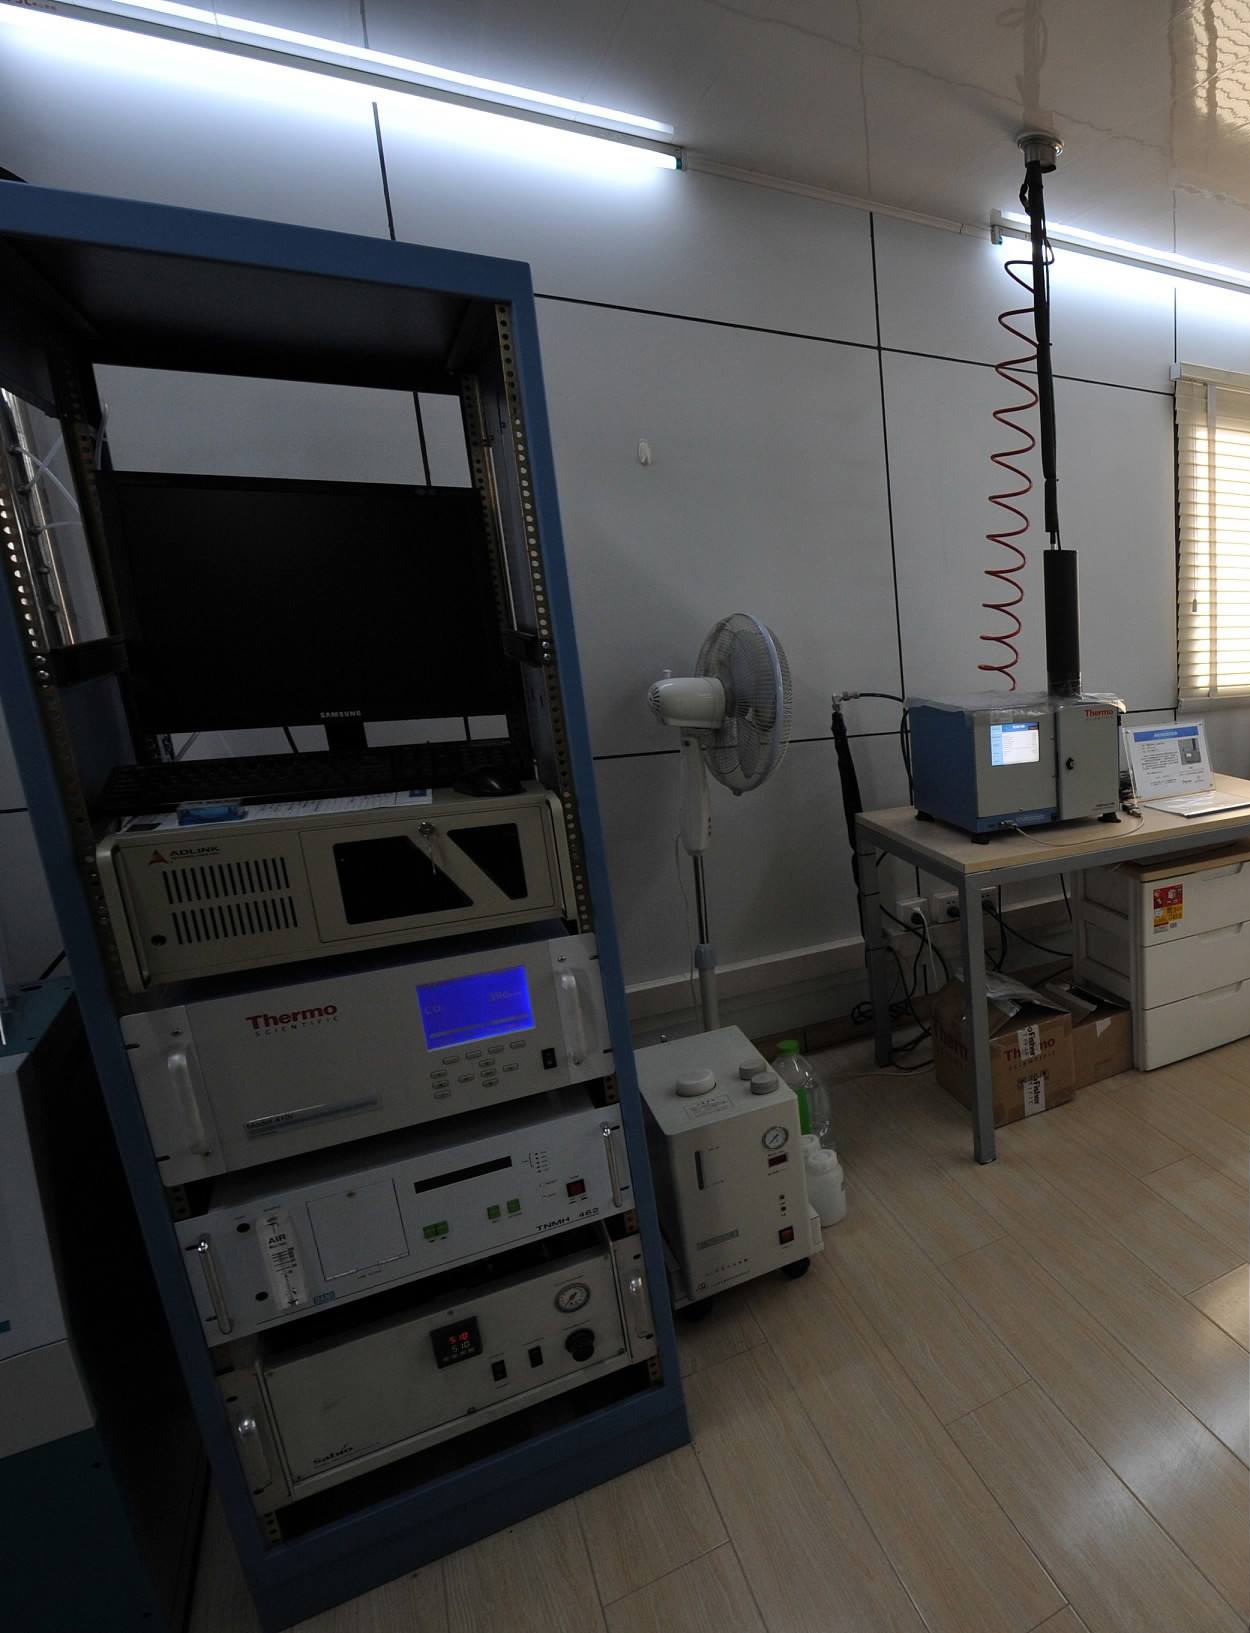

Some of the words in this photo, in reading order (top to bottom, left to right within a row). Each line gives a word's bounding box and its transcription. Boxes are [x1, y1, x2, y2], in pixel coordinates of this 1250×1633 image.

[319, 709, 362, 719] SAMSUNG
[1084, 708, 1114, 718] Thermo
[169, 845, 221, 857] ADLINK
[245, 1003, 338, 1031] Thermo
[254, 1015, 340, 1038] SCIENTIFIC
[535, 1216, 570, 1231] TNMH
[268, 1233, 287, 1245] AIR
